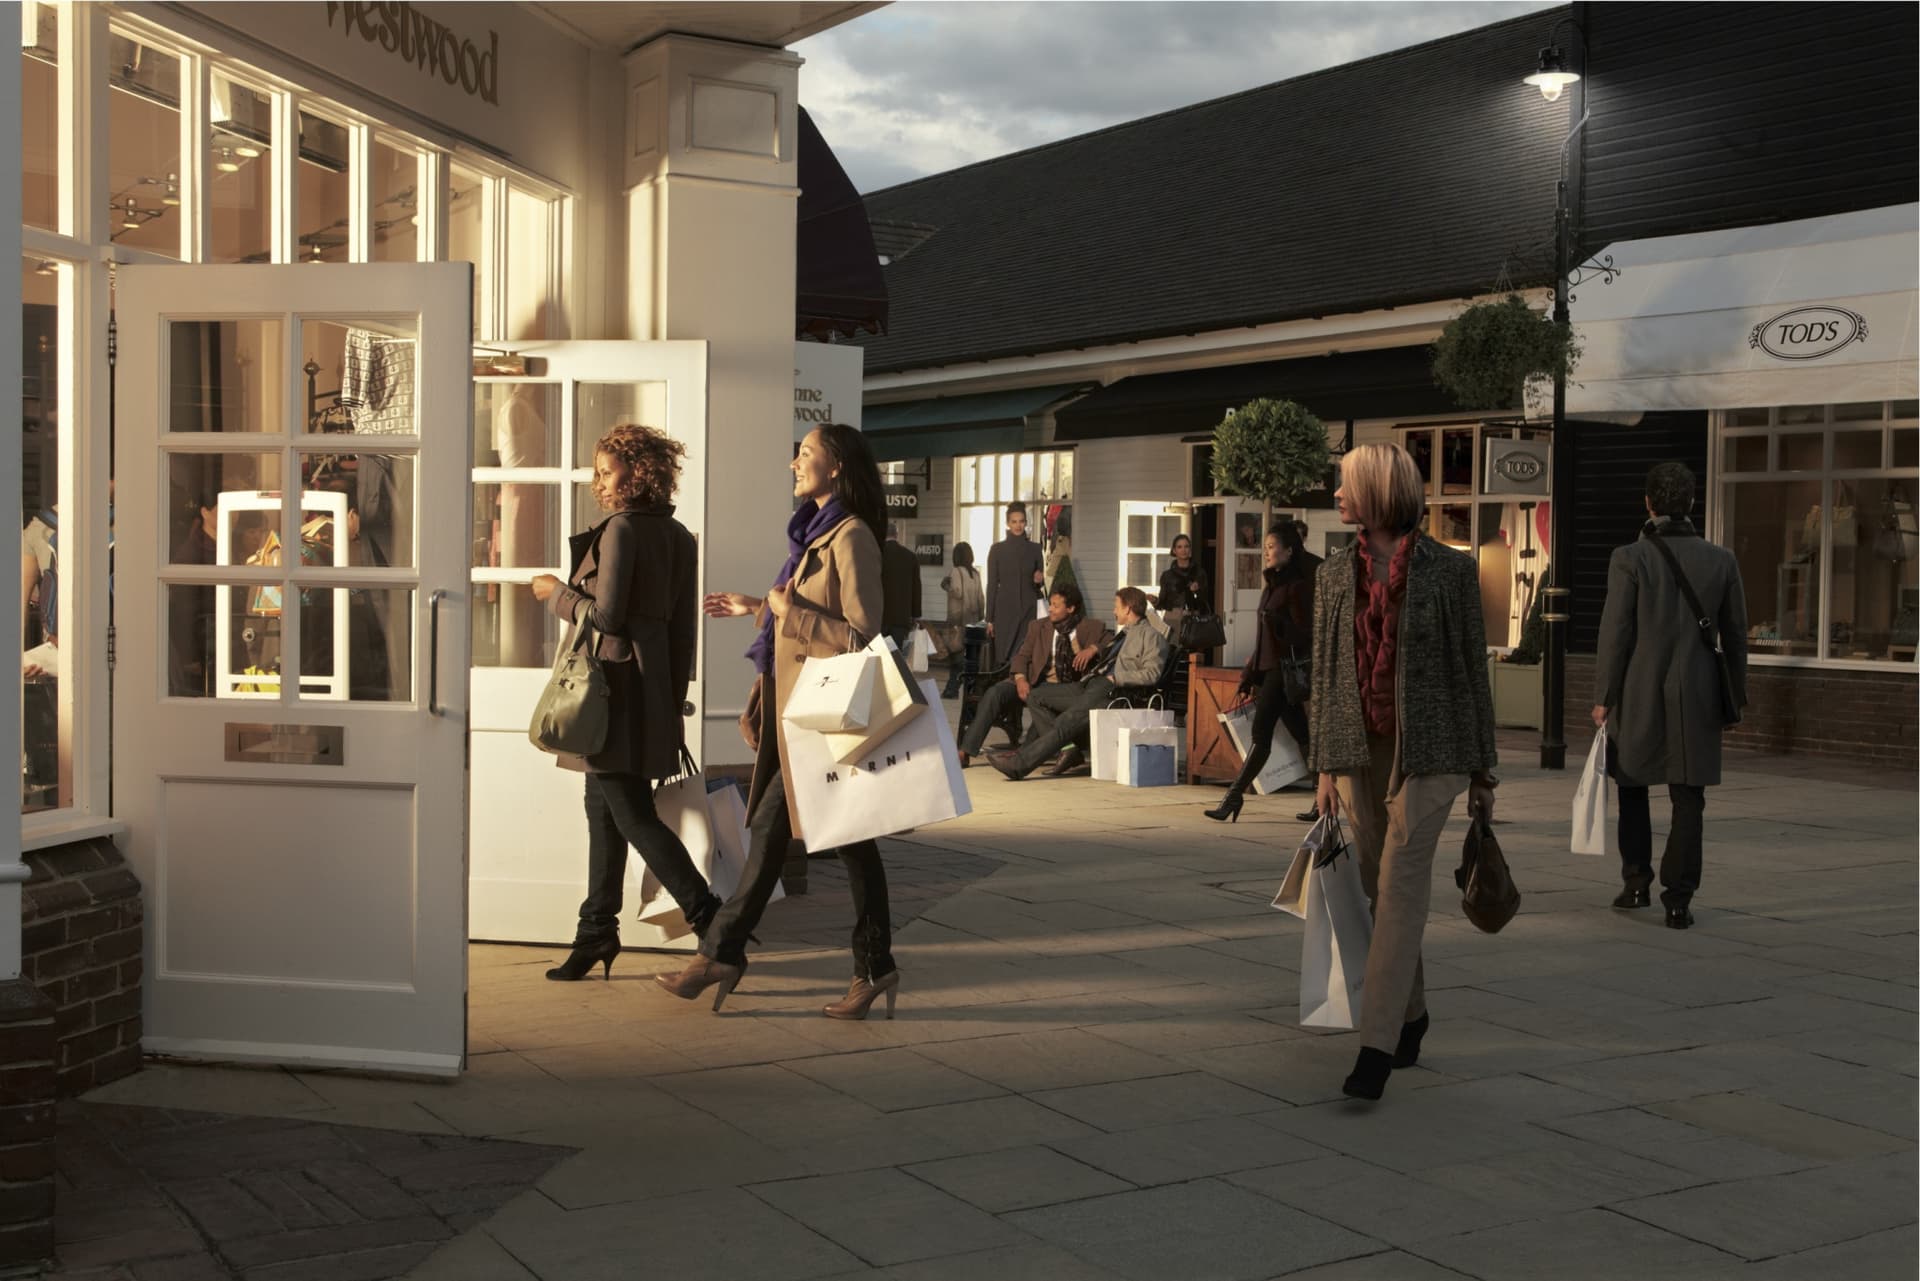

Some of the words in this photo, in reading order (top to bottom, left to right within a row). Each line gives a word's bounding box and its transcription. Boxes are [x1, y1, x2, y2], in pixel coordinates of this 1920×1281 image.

[1779, 320, 1840, 345] TOD'S
[886, 494, 917, 507] USTO
[826, 751, 911, 783] MARNI
